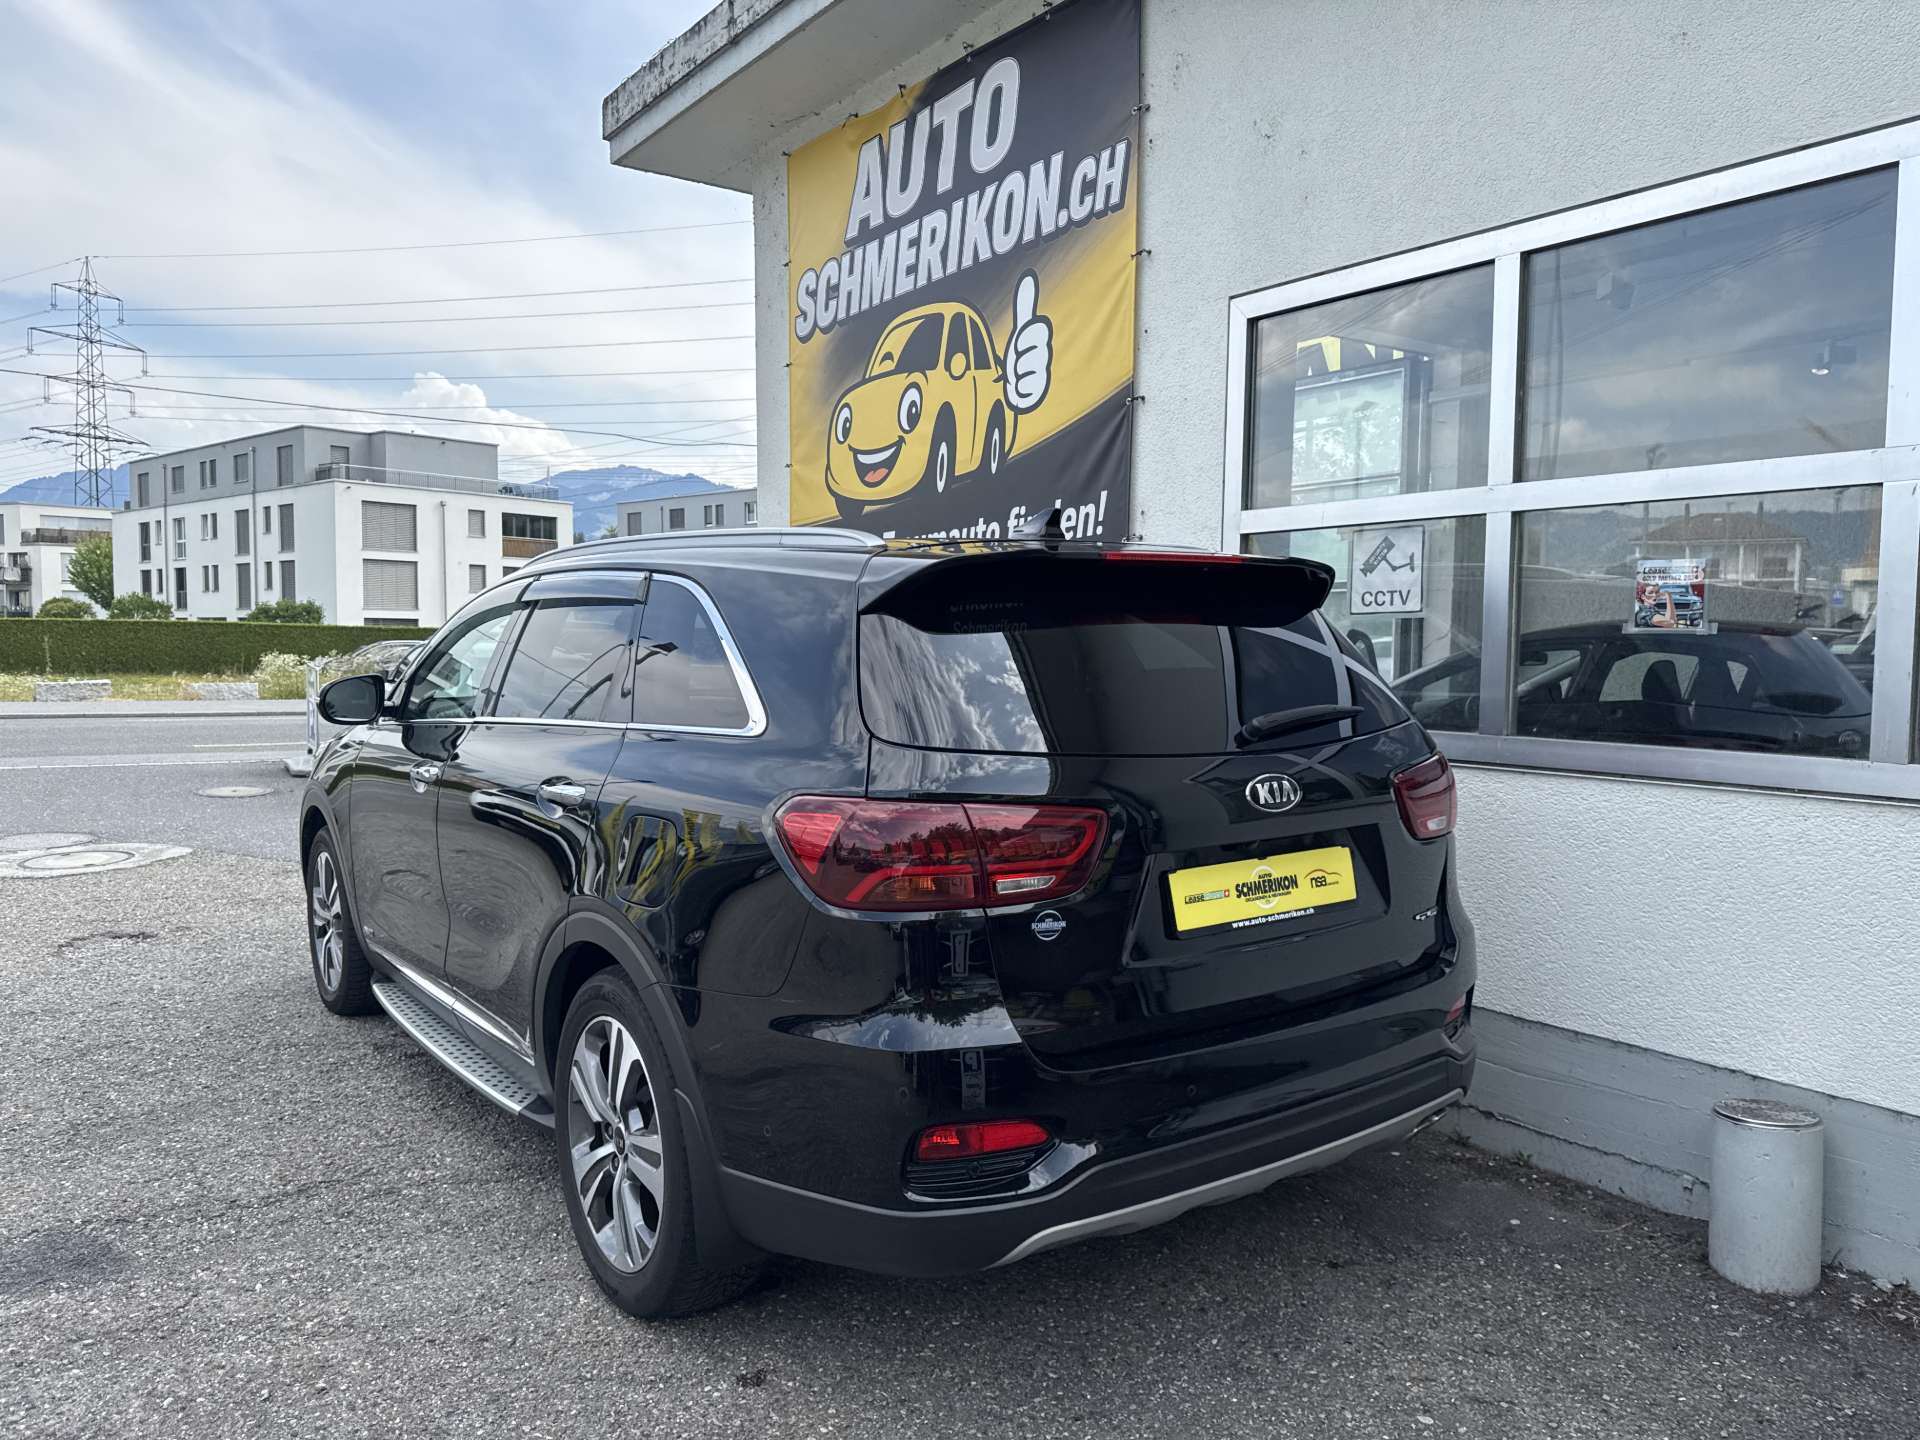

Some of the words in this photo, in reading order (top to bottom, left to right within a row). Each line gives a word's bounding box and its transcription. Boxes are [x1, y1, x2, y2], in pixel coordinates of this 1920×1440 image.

[845, 56, 1021, 242] AUTO
[794, 138, 1129, 341] SCHMERIKON.CH
[1008, 490, 1107, 540] fien!
[1361, 589, 1411, 607] CCTV
[1255, 780, 1295, 804] KIA
[1235, 874, 1298, 898] SCHMERIKON
[1232, 908, 1314, 928] www.auto-schmerikon.ch
